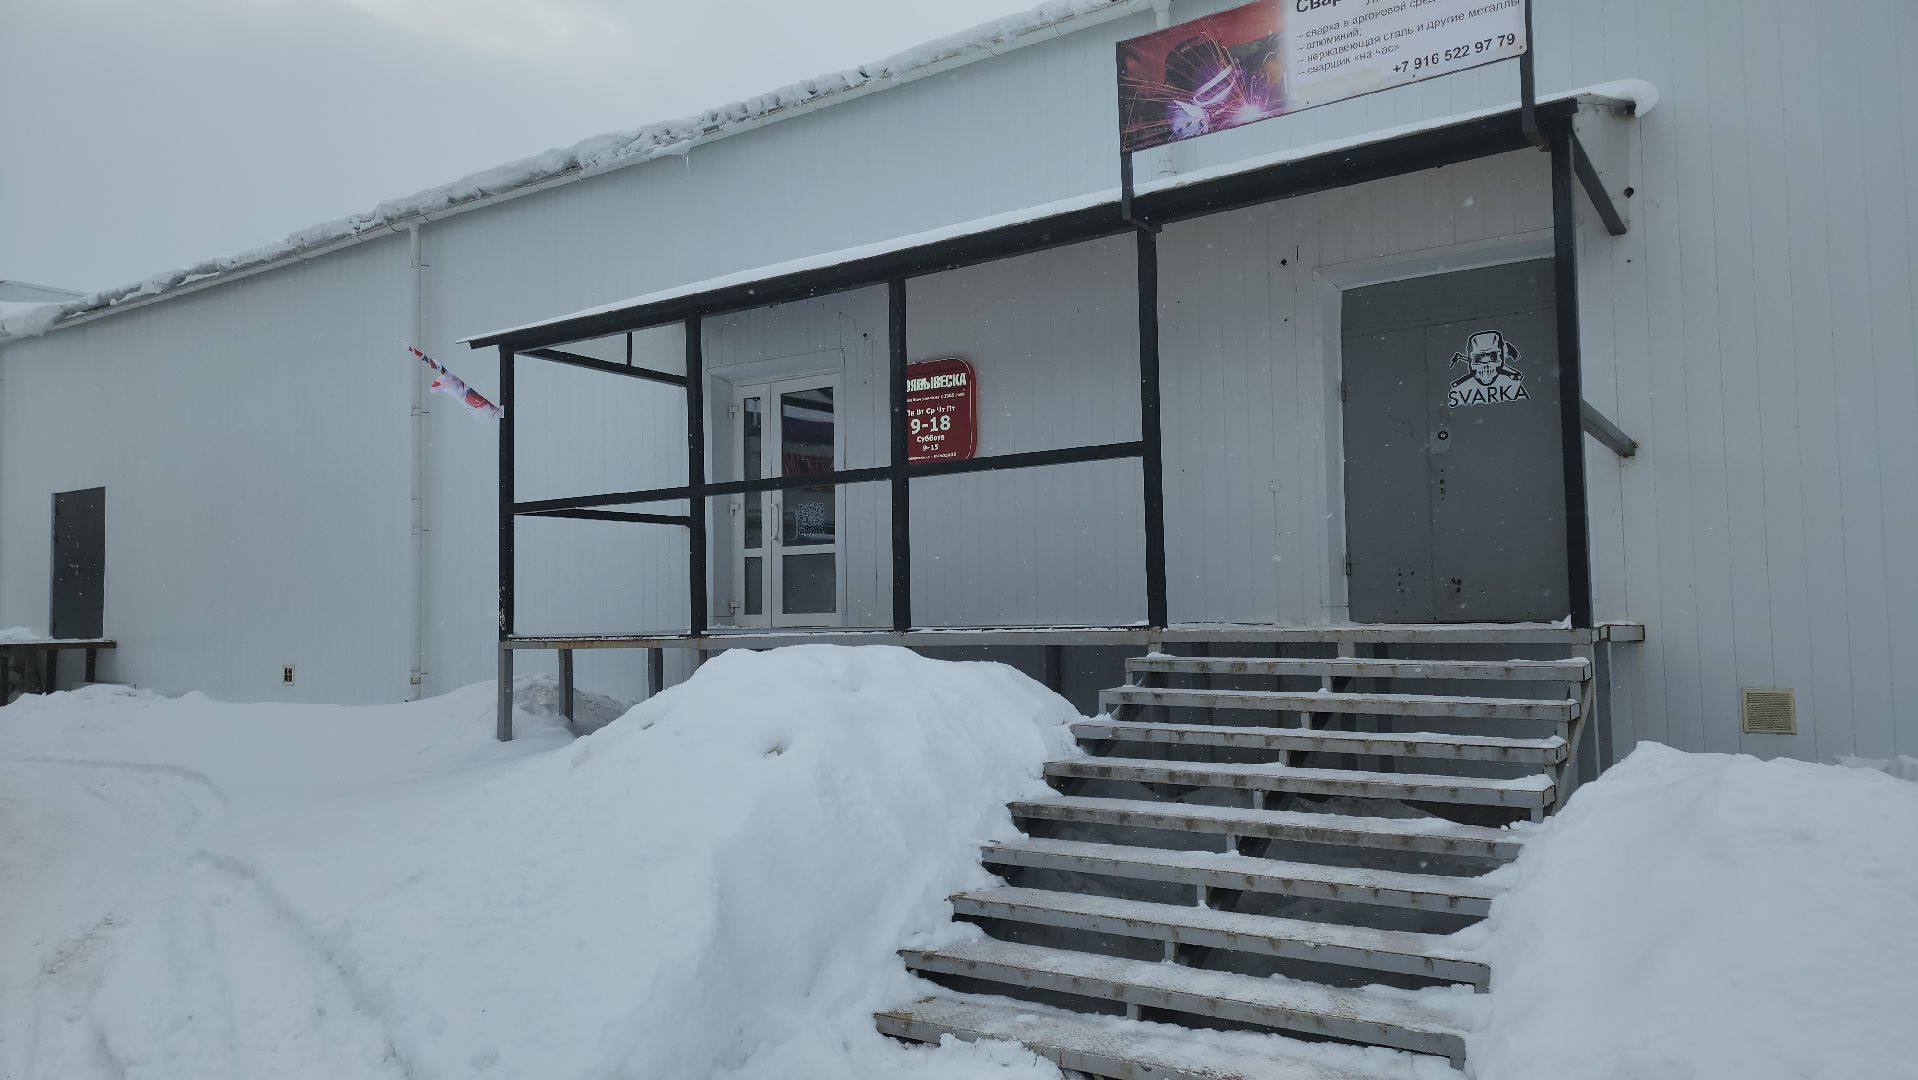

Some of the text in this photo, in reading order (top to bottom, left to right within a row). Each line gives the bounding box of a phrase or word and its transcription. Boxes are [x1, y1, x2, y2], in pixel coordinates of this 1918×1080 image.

[1306, 22, 1340, 38] сварка
[1352, 2, 1406, 25] аргоновой
[1307, 35, 1381, 63] нержавеющая
[1383, 26, 1414, 41] сталь
[1417, 23, 1424, 32] и
[1426, 12, 1465, 31] другие
[1468, 0, 1520, 18] металлы
[1392, 32, 1516, 73] +7 916 522 97 79
[1307, 57, 1351, 75] сварщик
[1448, 384, 1530, 408] SVARKA
[926, 407, 936, 416] Ср
[910, 414, 951, 435] 9-18
[916, 434, 945, 444] Суббота
[922, 443, 939, 452] 9-15
